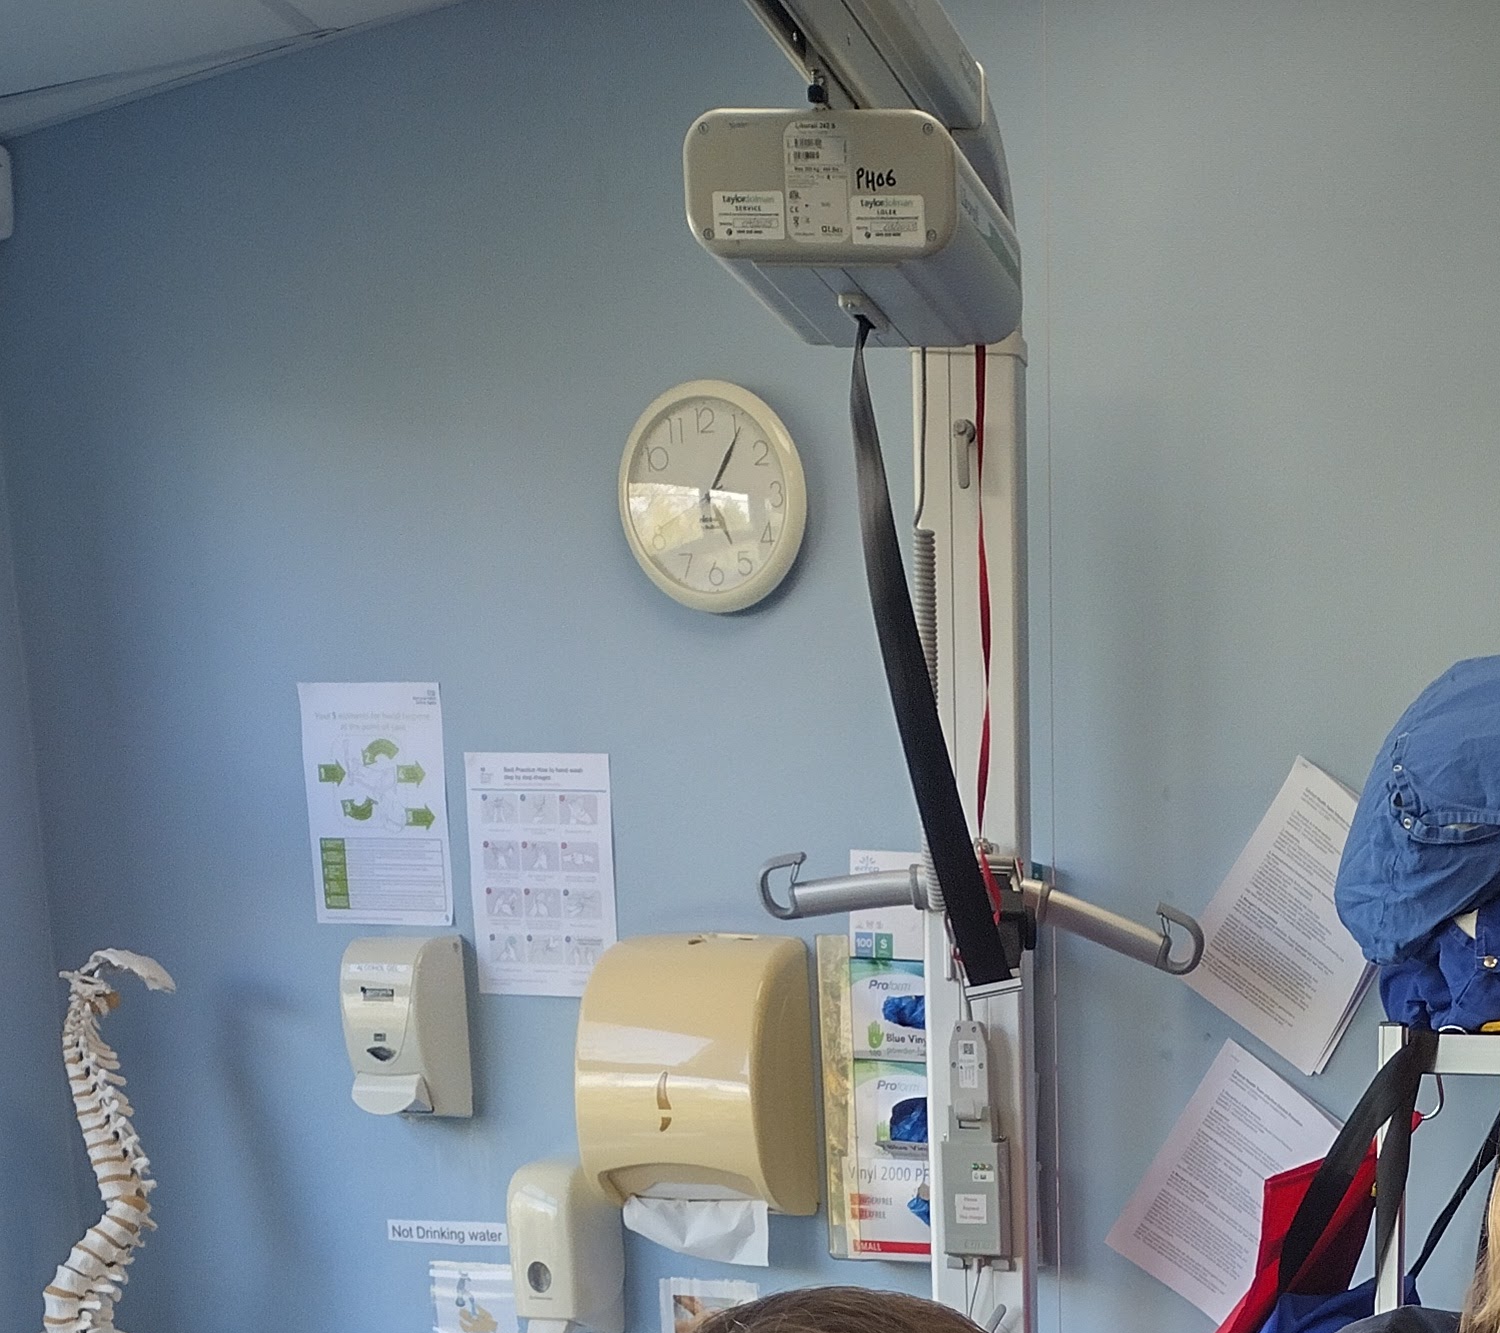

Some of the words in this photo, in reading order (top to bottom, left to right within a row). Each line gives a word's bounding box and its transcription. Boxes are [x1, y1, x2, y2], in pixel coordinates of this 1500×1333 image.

[856, 167, 897, 191] PH06
[668, 418, 684, 444] 11
[695, 407, 715, 434] 12
[645, 446, 669, 472] 10
[753, 440, 769, 466] 2
[770, 483, 784, 508] 3
[652, 525, 667, 550] 8
[760, 520, 775, 546] 4
[679, 553, 694, 578] 7
[708, 560, 724, 586] 6
[737, 551, 753, 576] 5
[856, 938, 873, 948] 100
[880, 939, 888, 949] S
[886, 1034, 906, 1043] Blue
[848, 1165, 877, 1184] Vnyl
[881, 1166, 911, 1181] 2000
[391, 1225, 413, 1239] Not
[416, 1226, 465, 1244] Drinking
[468, 1229, 503, 1242] water
[855, 1242, 882, 1252] SMALL
